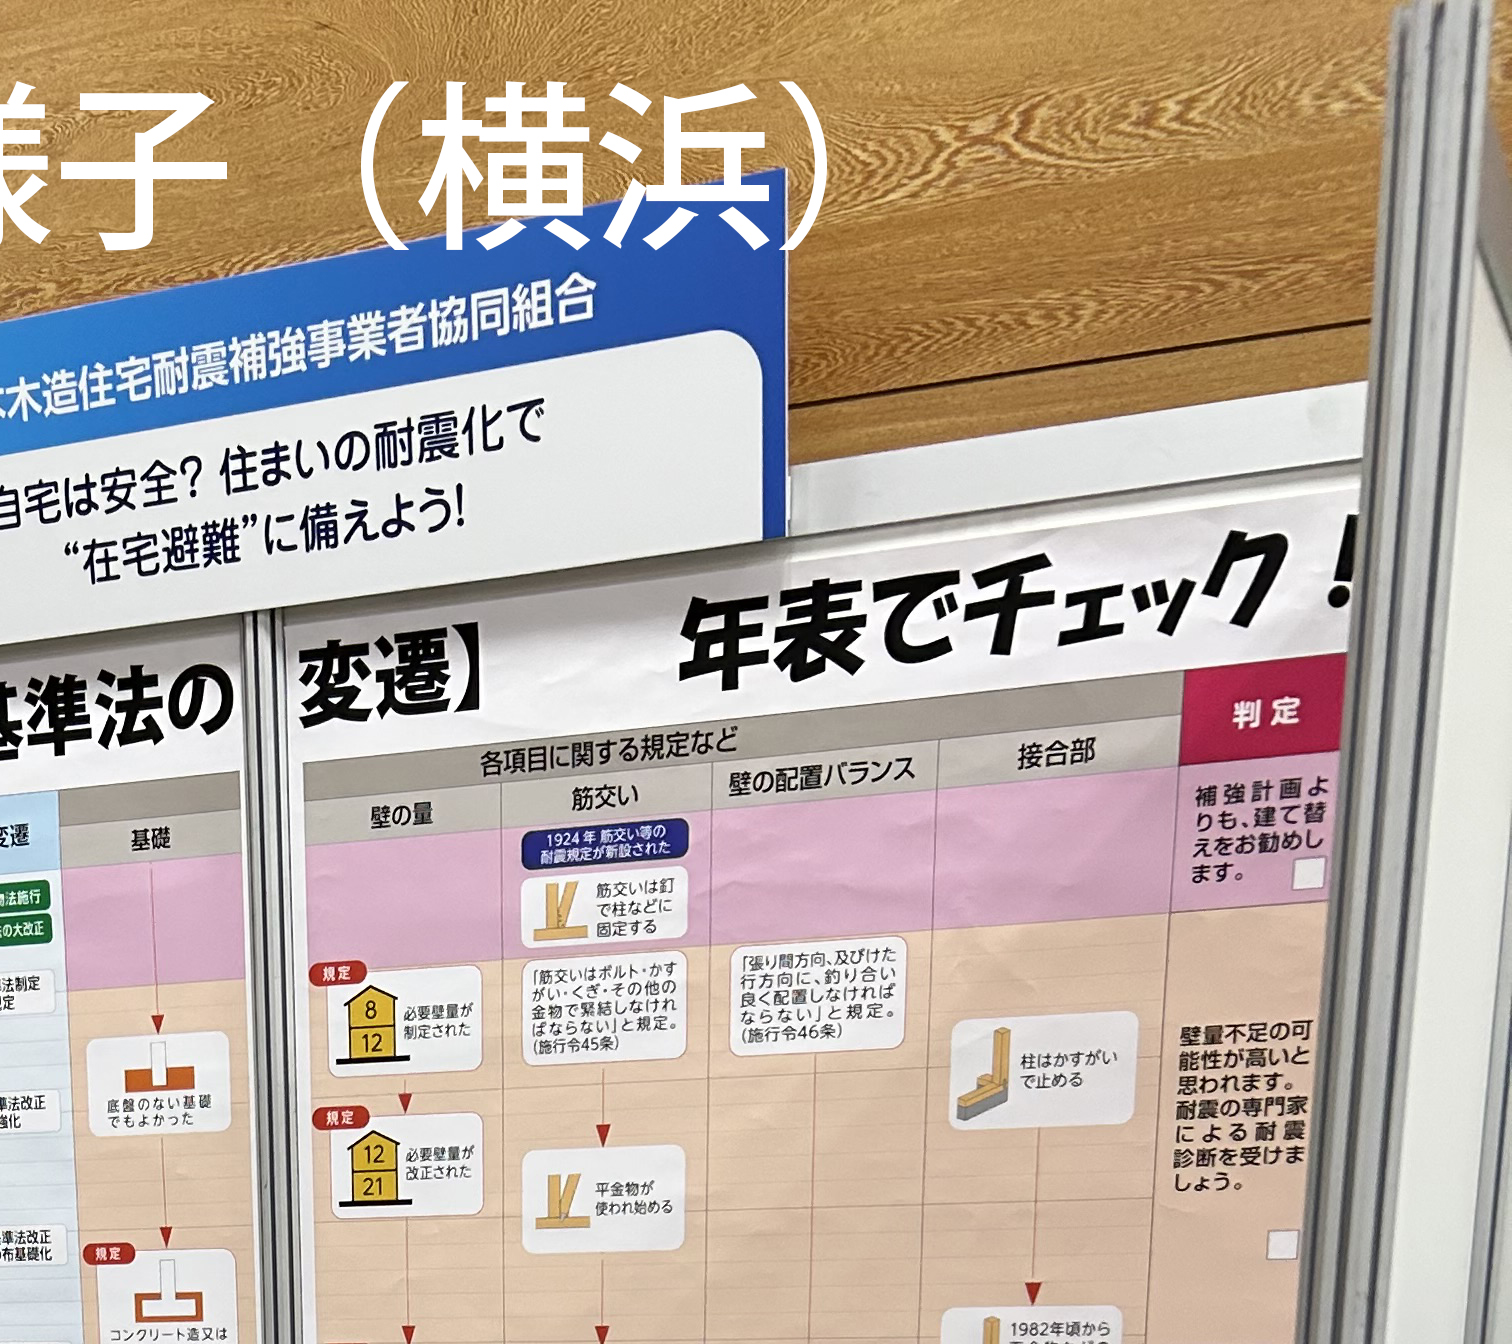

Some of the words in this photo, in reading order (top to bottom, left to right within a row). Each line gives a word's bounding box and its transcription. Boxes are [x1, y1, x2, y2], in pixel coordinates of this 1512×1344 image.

[219, 398, 546, 494] 住まいの耐震化で
[297, 622, 481, 730] 変遷】
[1232, 697, 1301, 730] 判定
[479, 726, 738, 775] 各項目に関する規定など
[1017, 737, 1097, 772] 接合部
[727, 756, 916, 798] 壁の配置バランス
[571, 782, 639, 810] 筋交い
[1195, 776, 1329, 807] 補強計画よ
[370, 799, 434, 829] 壁の量
[131, 824, 171, 851] 基礎
[1193, 830, 1324, 858] えをお勧めし
[596, 878, 674, 898] 筋交いは釘
[596, 899, 672, 917] で柱などに
[597, 920, 657, 937] 固定する
[403, 1023, 471, 1040] 制定された
[1180, 1020, 1313, 1046] 壁量不足の可
[1020, 1050, 1118, 1070] 柱はかすがい
[1179, 1046, 1310, 1070] 能性が高いと
[1020, 1072, 1083, 1090] で止める
[107, 1094, 212, 1113] 底盤のない基礎
[109, 1112, 193, 1128] でもよかった
[406, 1164, 472, 1181] 改正された
[595, 1181, 654, 1197] 平金物が
[595, 1199, 673, 1216] 使われ始める
[110, 1328, 227, 1342] コンクリート造又は
[1011, 1322, 1111, 1338] 1982年頃から
